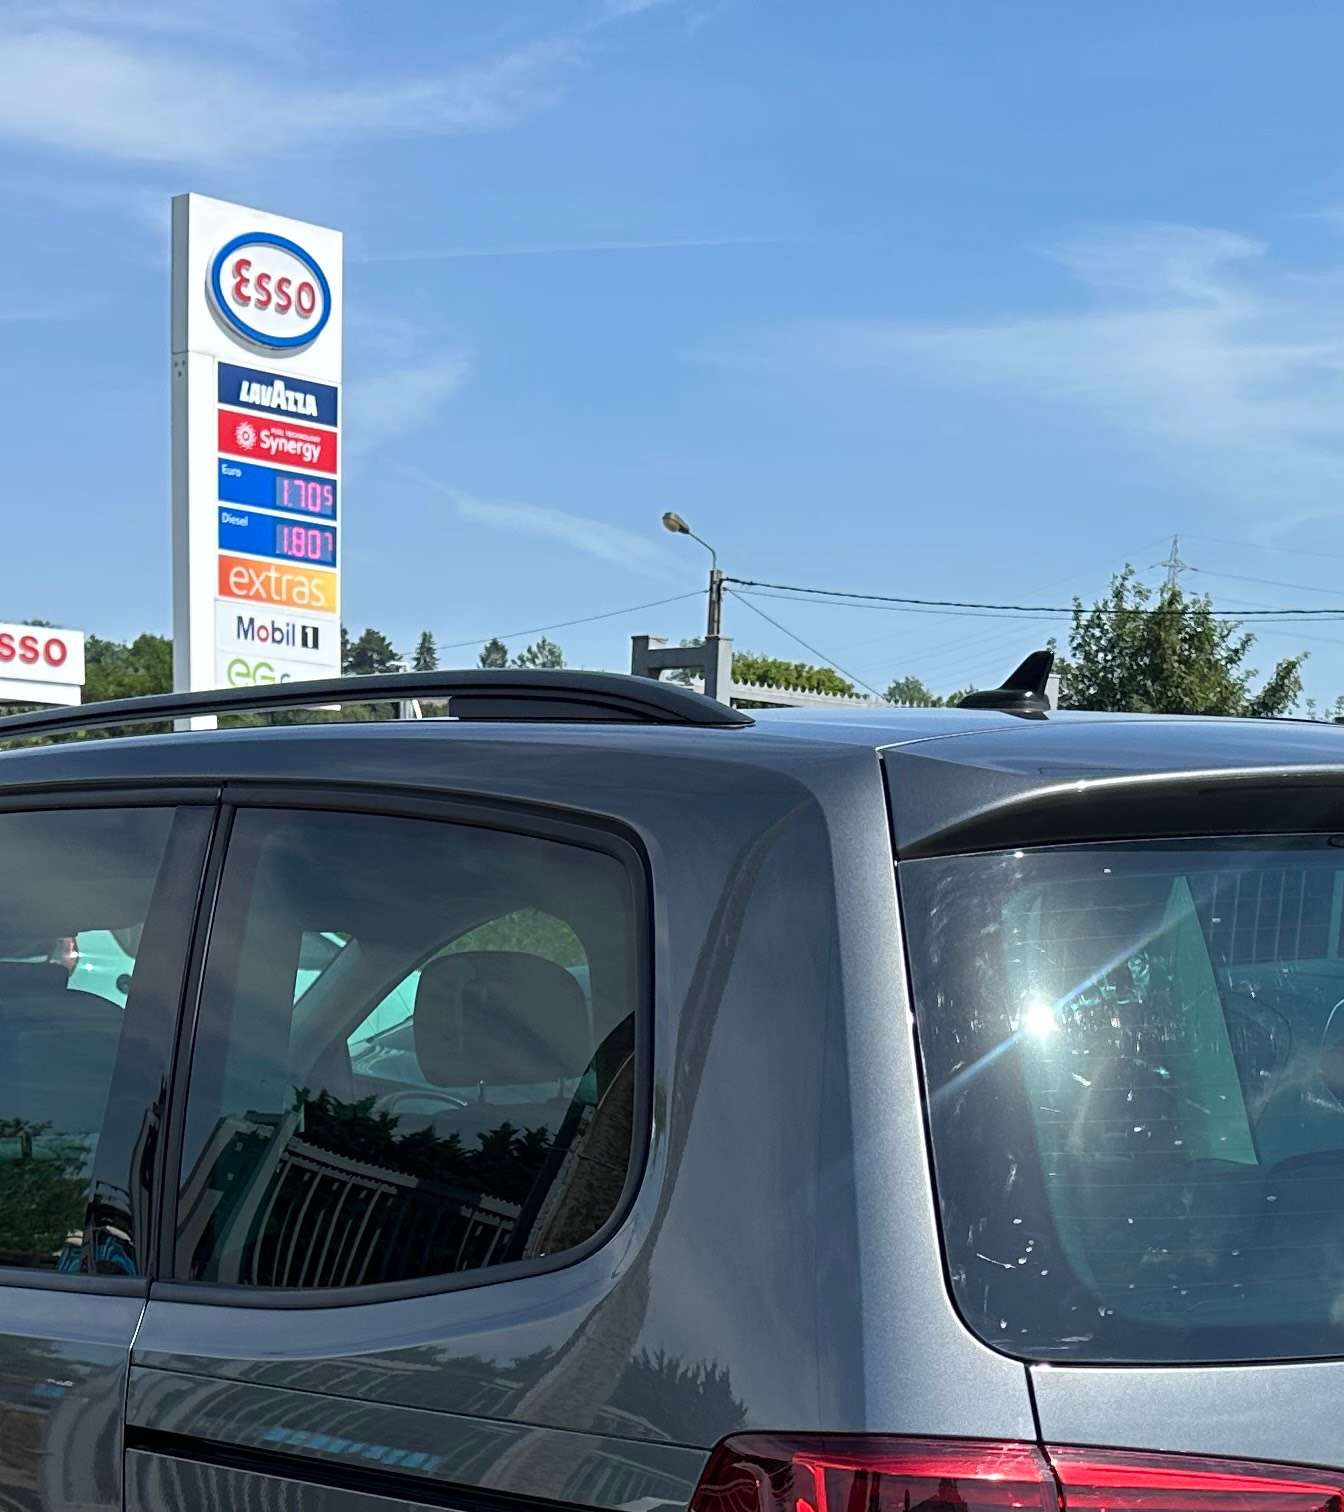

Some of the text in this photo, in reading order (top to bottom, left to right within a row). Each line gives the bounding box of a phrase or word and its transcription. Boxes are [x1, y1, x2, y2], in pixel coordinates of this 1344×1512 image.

[239, 379, 318, 417] LAVAZZA
[259, 429, 321, 463] Synergy
[221, 463, 242, 477] Euro
[221, 512, 249, 527] Diesel
[229, 566, 326, 606] extras
[237, 616, 296, 647] Mobil
